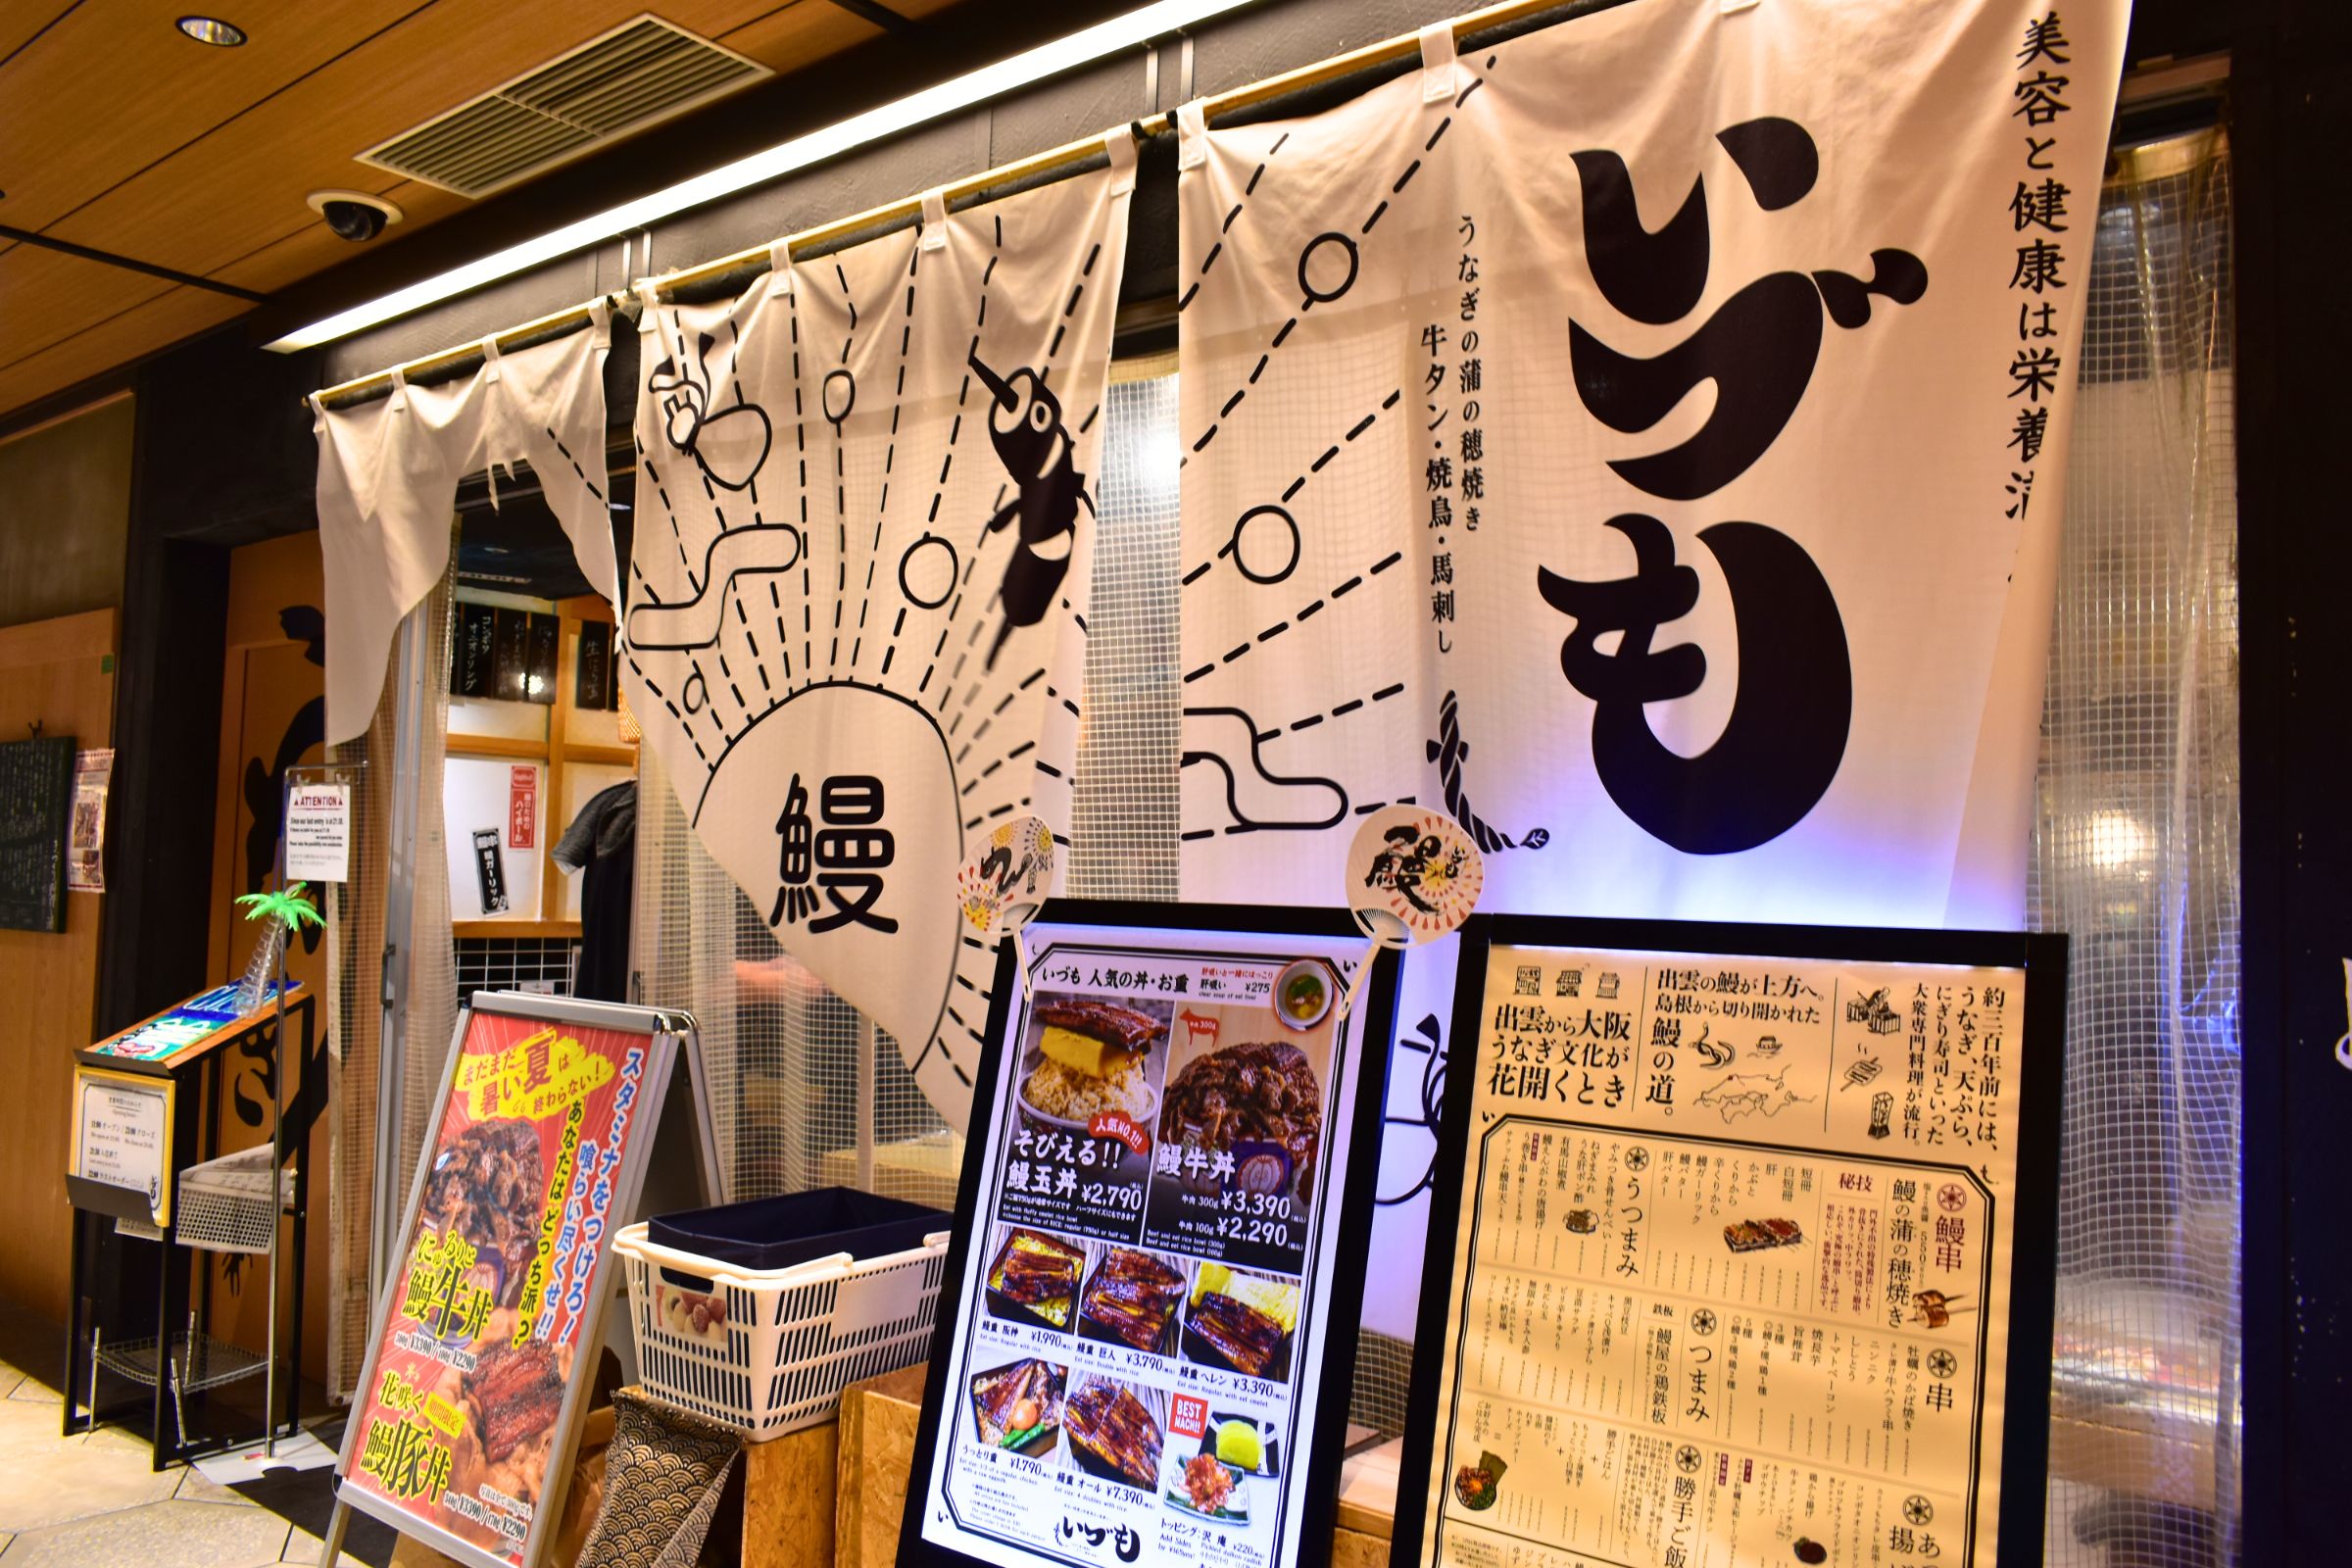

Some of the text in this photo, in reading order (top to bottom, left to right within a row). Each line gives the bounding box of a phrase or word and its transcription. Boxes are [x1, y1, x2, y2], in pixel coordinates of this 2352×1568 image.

[1458, 215, 1484, 531] うなぎの蒲の穂焼き
[1420, 323, 1455, 654] 牛タン・焼鳥・馬刺し
[1538, 117, 1928, 854] いづも
[301, 796, 337, 807] ATTENTION
[514, 800, 523, 843] ハイボール
[770, 772, 899, 934] 鰻
[1042, 966, 1190, 994] いづも 人気の丼・お重
[1200, 979, 1270, 994] 肝吸い ¥275
[1344, 960, 1357, 973] い
[1657, 968, 1824, 1002] 出雲の鰻が上方へ。
[1494, 1003, 1632, 1041] 出雲から大阪
[1655, 993, 1820, 1024] 島根から切り開かれた
[464, 1048, 519, 1087] まだまだ
[1492, 1034, 1630, 1069] うなぎ文化が
[1645, 1016, 1682, 1116] 鰻の道。
[1903, 983, 1929, 1147] 大衆専門料理が流行。
[1927, 985, 1952, 1146] にぎり寿司といった
[1950, 986, 1978, 1147] うなぎ、天ぷら、
[1977, 987, 2005, 1152] 約三百年前には、
[532, 1061, 601, 1115] 終わらない!
[1487, 1062, 1625, 1108] 花開くとき
[1096, 1117, 1143, 1150] 人気NO.1!!
[1482, 1110, 1495, 1122] い
[1014, 1128, 1121, 1169] そびえる!!
[1156, 1143, 1235, 1184] 鰻牛丼
[1005, 1159, 1078, 1200] 鰻玉丼
[1081, 1183, 1143, 1211] ¥2,790
[1661, 1152, 1674, 1198] 肝バター
[1679, 1152, 1690, 1200] 鰻バター
[1692, 1154, 1708, 1225] 鰻ガーリック
[1729, 1159, 1740, 1206] くりから
[1747, 1162, 1759, 1197] かぶと
[1766, 1163, 1778, 1176] 肝
[1782, 1166, 1794, 1202] 白短冊
[1800, 1168, 1813, 1193] 短冊
[1839, 1172, 1873, 1193] 秘技
[560, 1050, 643, 1344] スタミナをつけろ!
[1198, 1196, 1219, 1209] 300g
[1221, 1190, 1292, 1220] ¥3,390
[514, 1099, 584, 1346] あなたはどっち派?
[537, 1143, 598, 1336] 喰らい尽くせ!!
[1196, 1222, 1214, 1236] 100g
[1217, 1217, 1288, 1247] ¥2,290
[1616, 1176, 1643, 1278] うつまみ
[1886, 1178, 1916, 1329] 鰻の蒲の穂焼き
[1936, 1214, 1965, 1274] 鰻串
[403, 1265, 492, 1339] 鰻牛丼
[1652, 1302, 1674, 1318] 鉄板
[1002, 1324, 1018, 1337] 阪神
[452, 1349, 475, 1371] ¥2290
[1100, 1347, 1116, 1361] 巨人
[379, 1370, 425, 1415] 花咲く
[1200, 1373, 1227, 1386] ヘレン
[1686, 1345, 1713, 1423] つまみ
[1926, 1383, 1953, 1412] 串
[428, 1399, 461, 1433] 期間限定
[1177, 1398, 1202, 1420] BEST
[361, 1420, 451, 1502] 鰻豚丼
[962, 1445, 998, 1463] うっとり重
[1078, 1478, 1102, 1494] オール
[502, 1517, 526, 1541] ¥2290
[1063, 1515, 1141, 1563] いづも
[1664, 1475, 1696, 1568] 勝手ご飯
[1233, 1544, 1252, 1555] ¥220
[1889, 1525, 1915, 1568] 揚
[1918, 1533, 1940, 1568] あ
